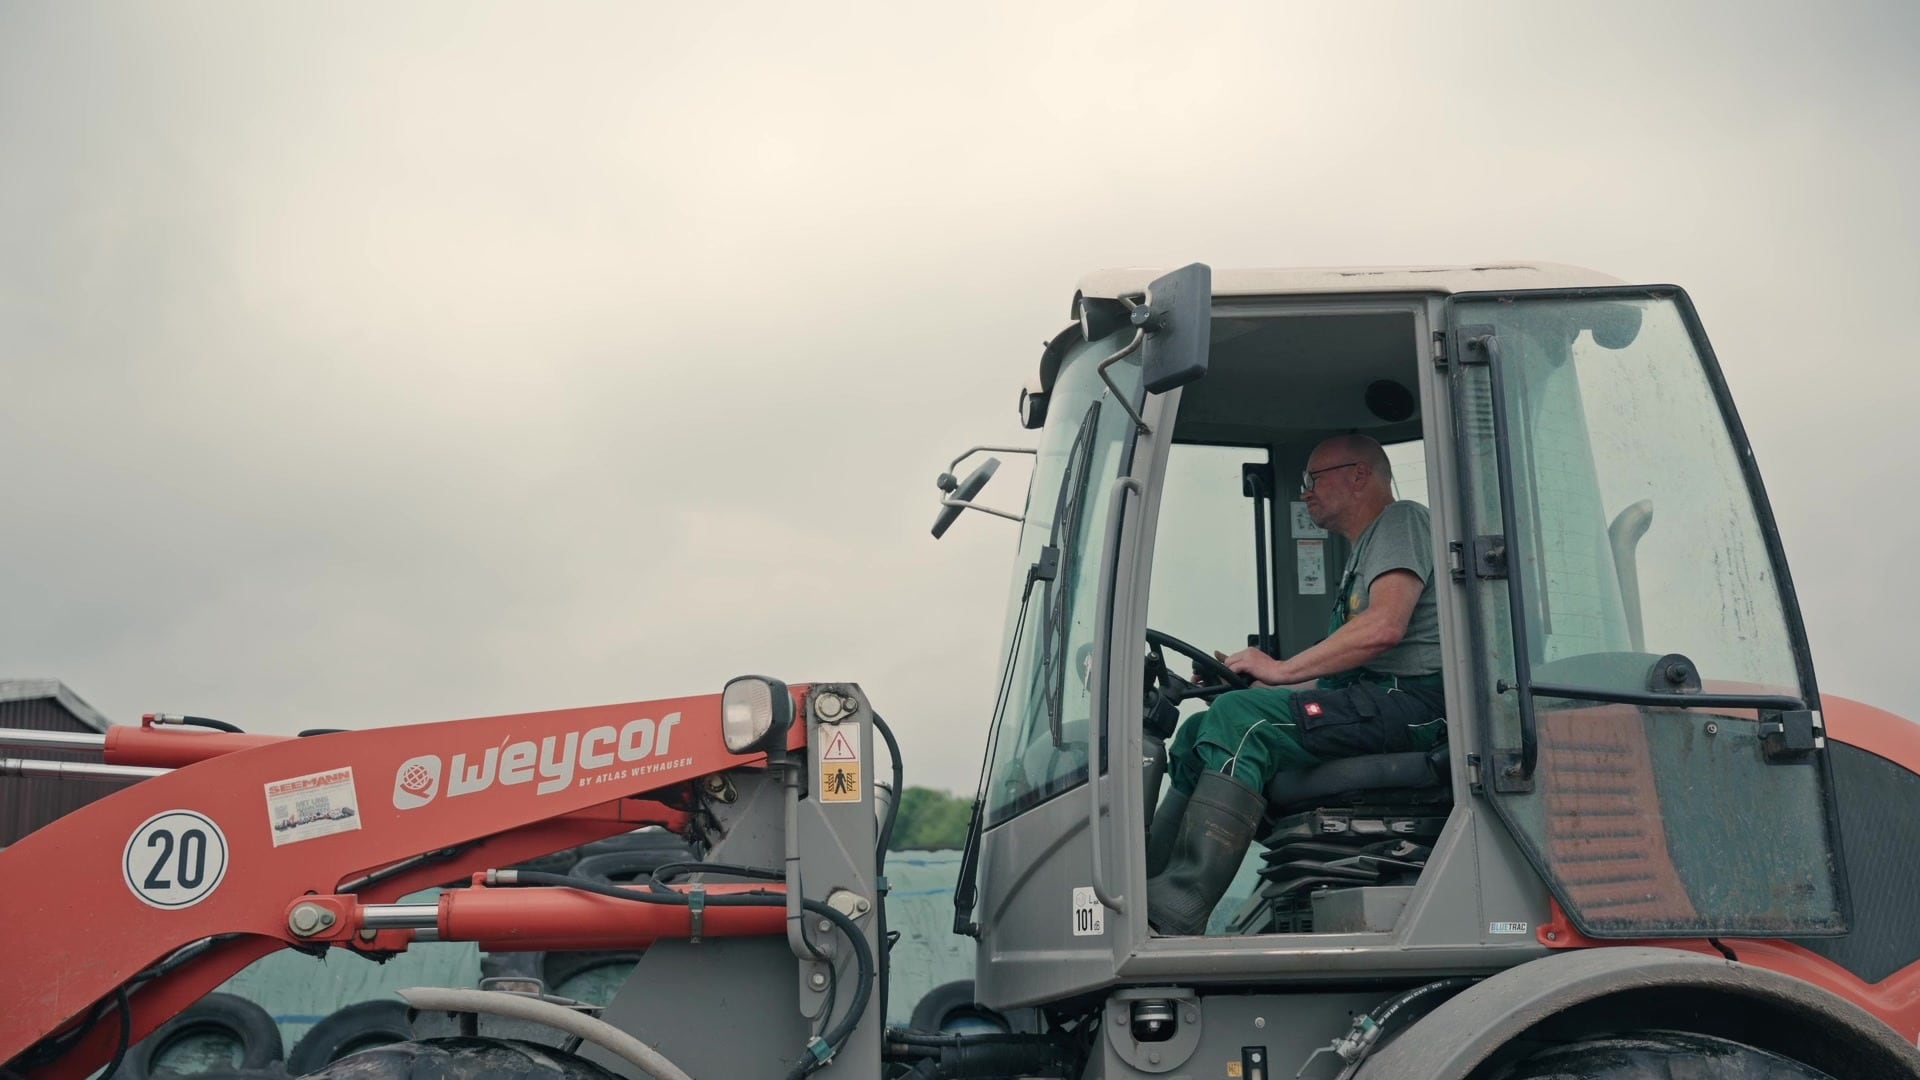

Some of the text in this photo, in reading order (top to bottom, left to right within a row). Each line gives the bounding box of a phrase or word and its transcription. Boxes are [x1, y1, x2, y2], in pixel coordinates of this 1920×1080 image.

[446, 711, 682, 798] weycor
[268, 771, 350, 794] SEEMANN
[578, 757, 693, 788] BY ATLAS WEYHAUSEN
[143, 828, 207, 890] 20
[1076, 908, 1093, 931] 101
[1491, 922, 1527, 931] BLUETRAC
